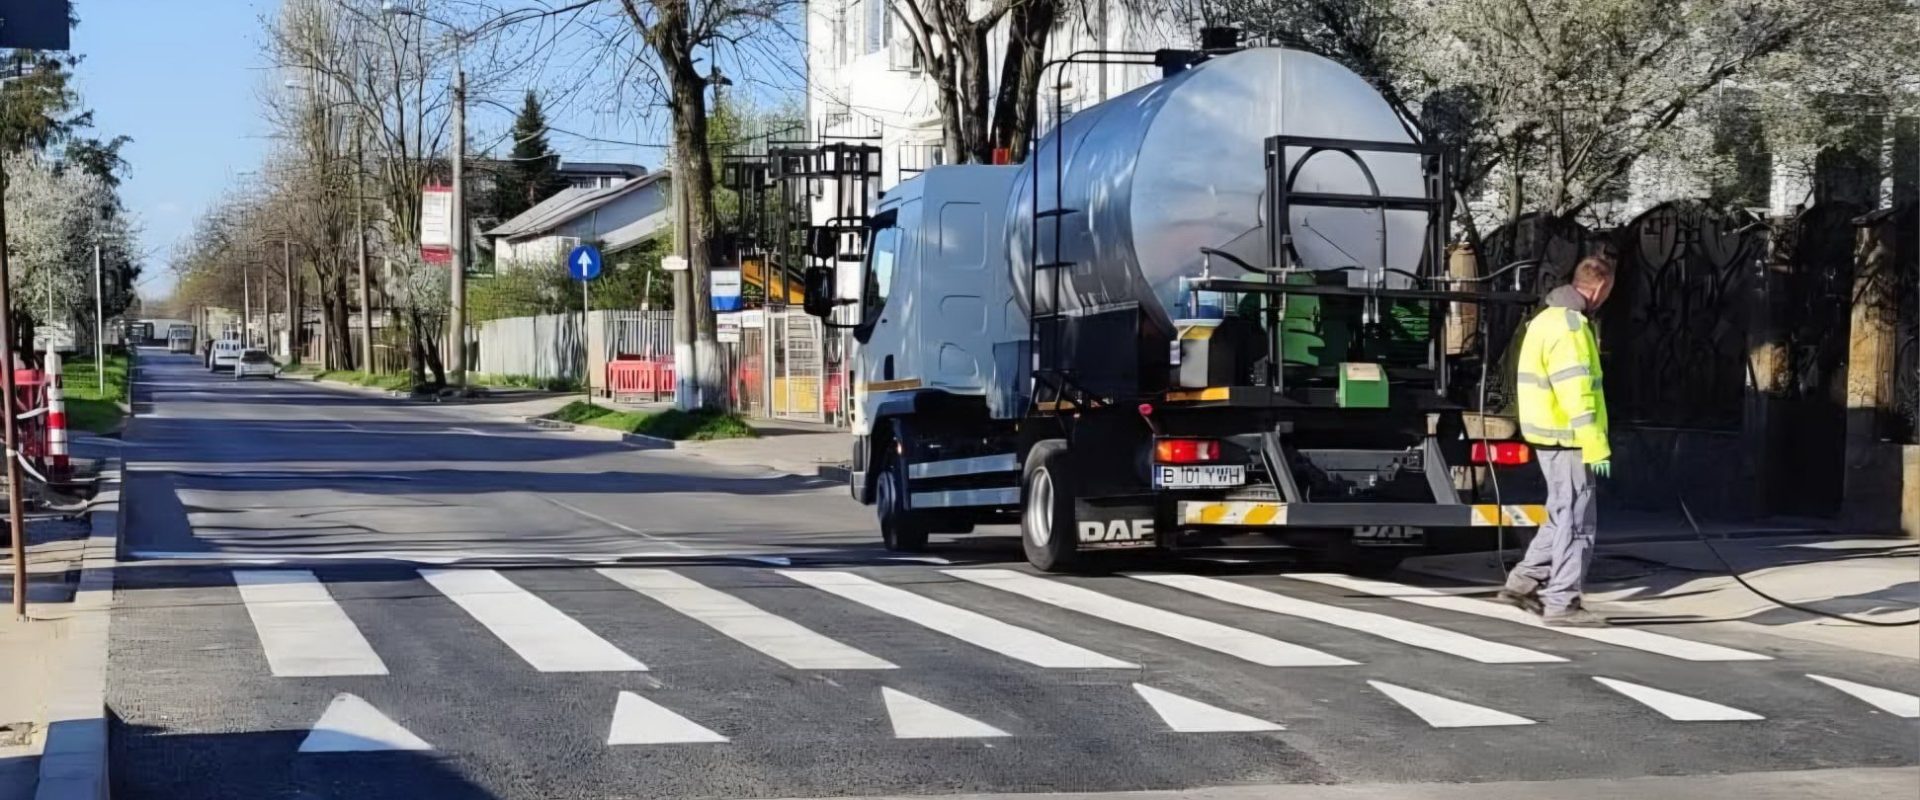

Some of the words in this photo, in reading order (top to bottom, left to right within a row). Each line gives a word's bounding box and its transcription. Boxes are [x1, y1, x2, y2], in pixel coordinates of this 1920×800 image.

[1163, 468, 1174, 484] B
[1181, 467, 1200, 484] 101
[1205, 467, 1240, 484] YWH
[1079, 519, 1154, 541] DAF
